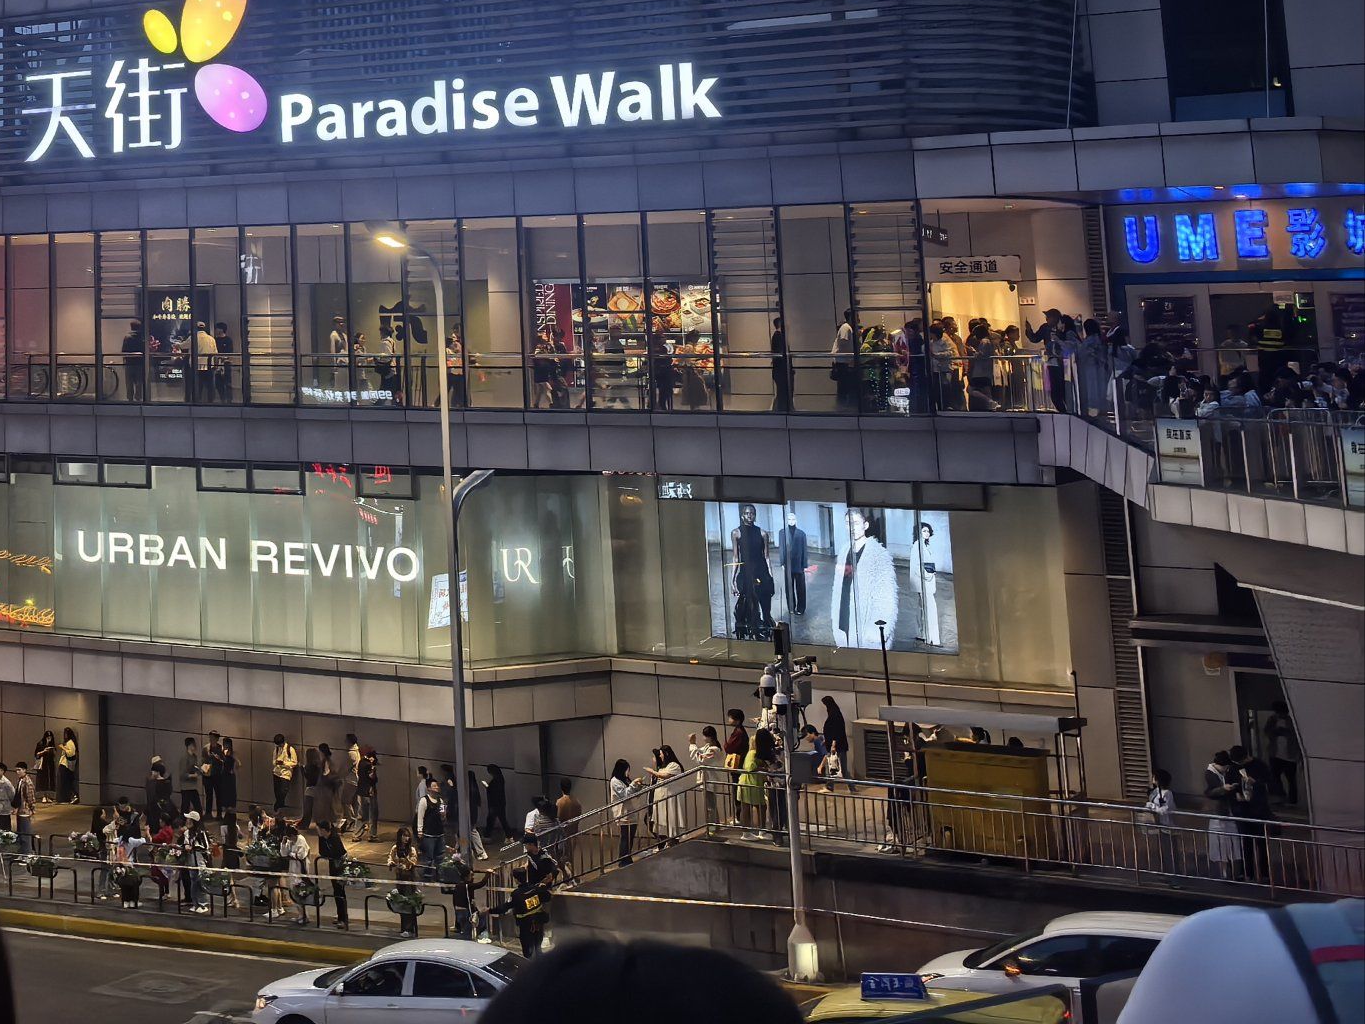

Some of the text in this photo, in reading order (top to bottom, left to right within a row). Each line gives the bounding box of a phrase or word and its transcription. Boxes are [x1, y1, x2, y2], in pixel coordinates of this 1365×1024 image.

[21, 57, 189, 163] 天街
[279, 62, 724, 144] Paradise Walk
[939, 260, 999, 275] 安全通道
[534, 282, 546, 333] NSPIRED
[544, 283, 557, 325] DINING
[77, 530, 420, 583] URBAN REVIVO
[500, 547, 540, 585] UR
